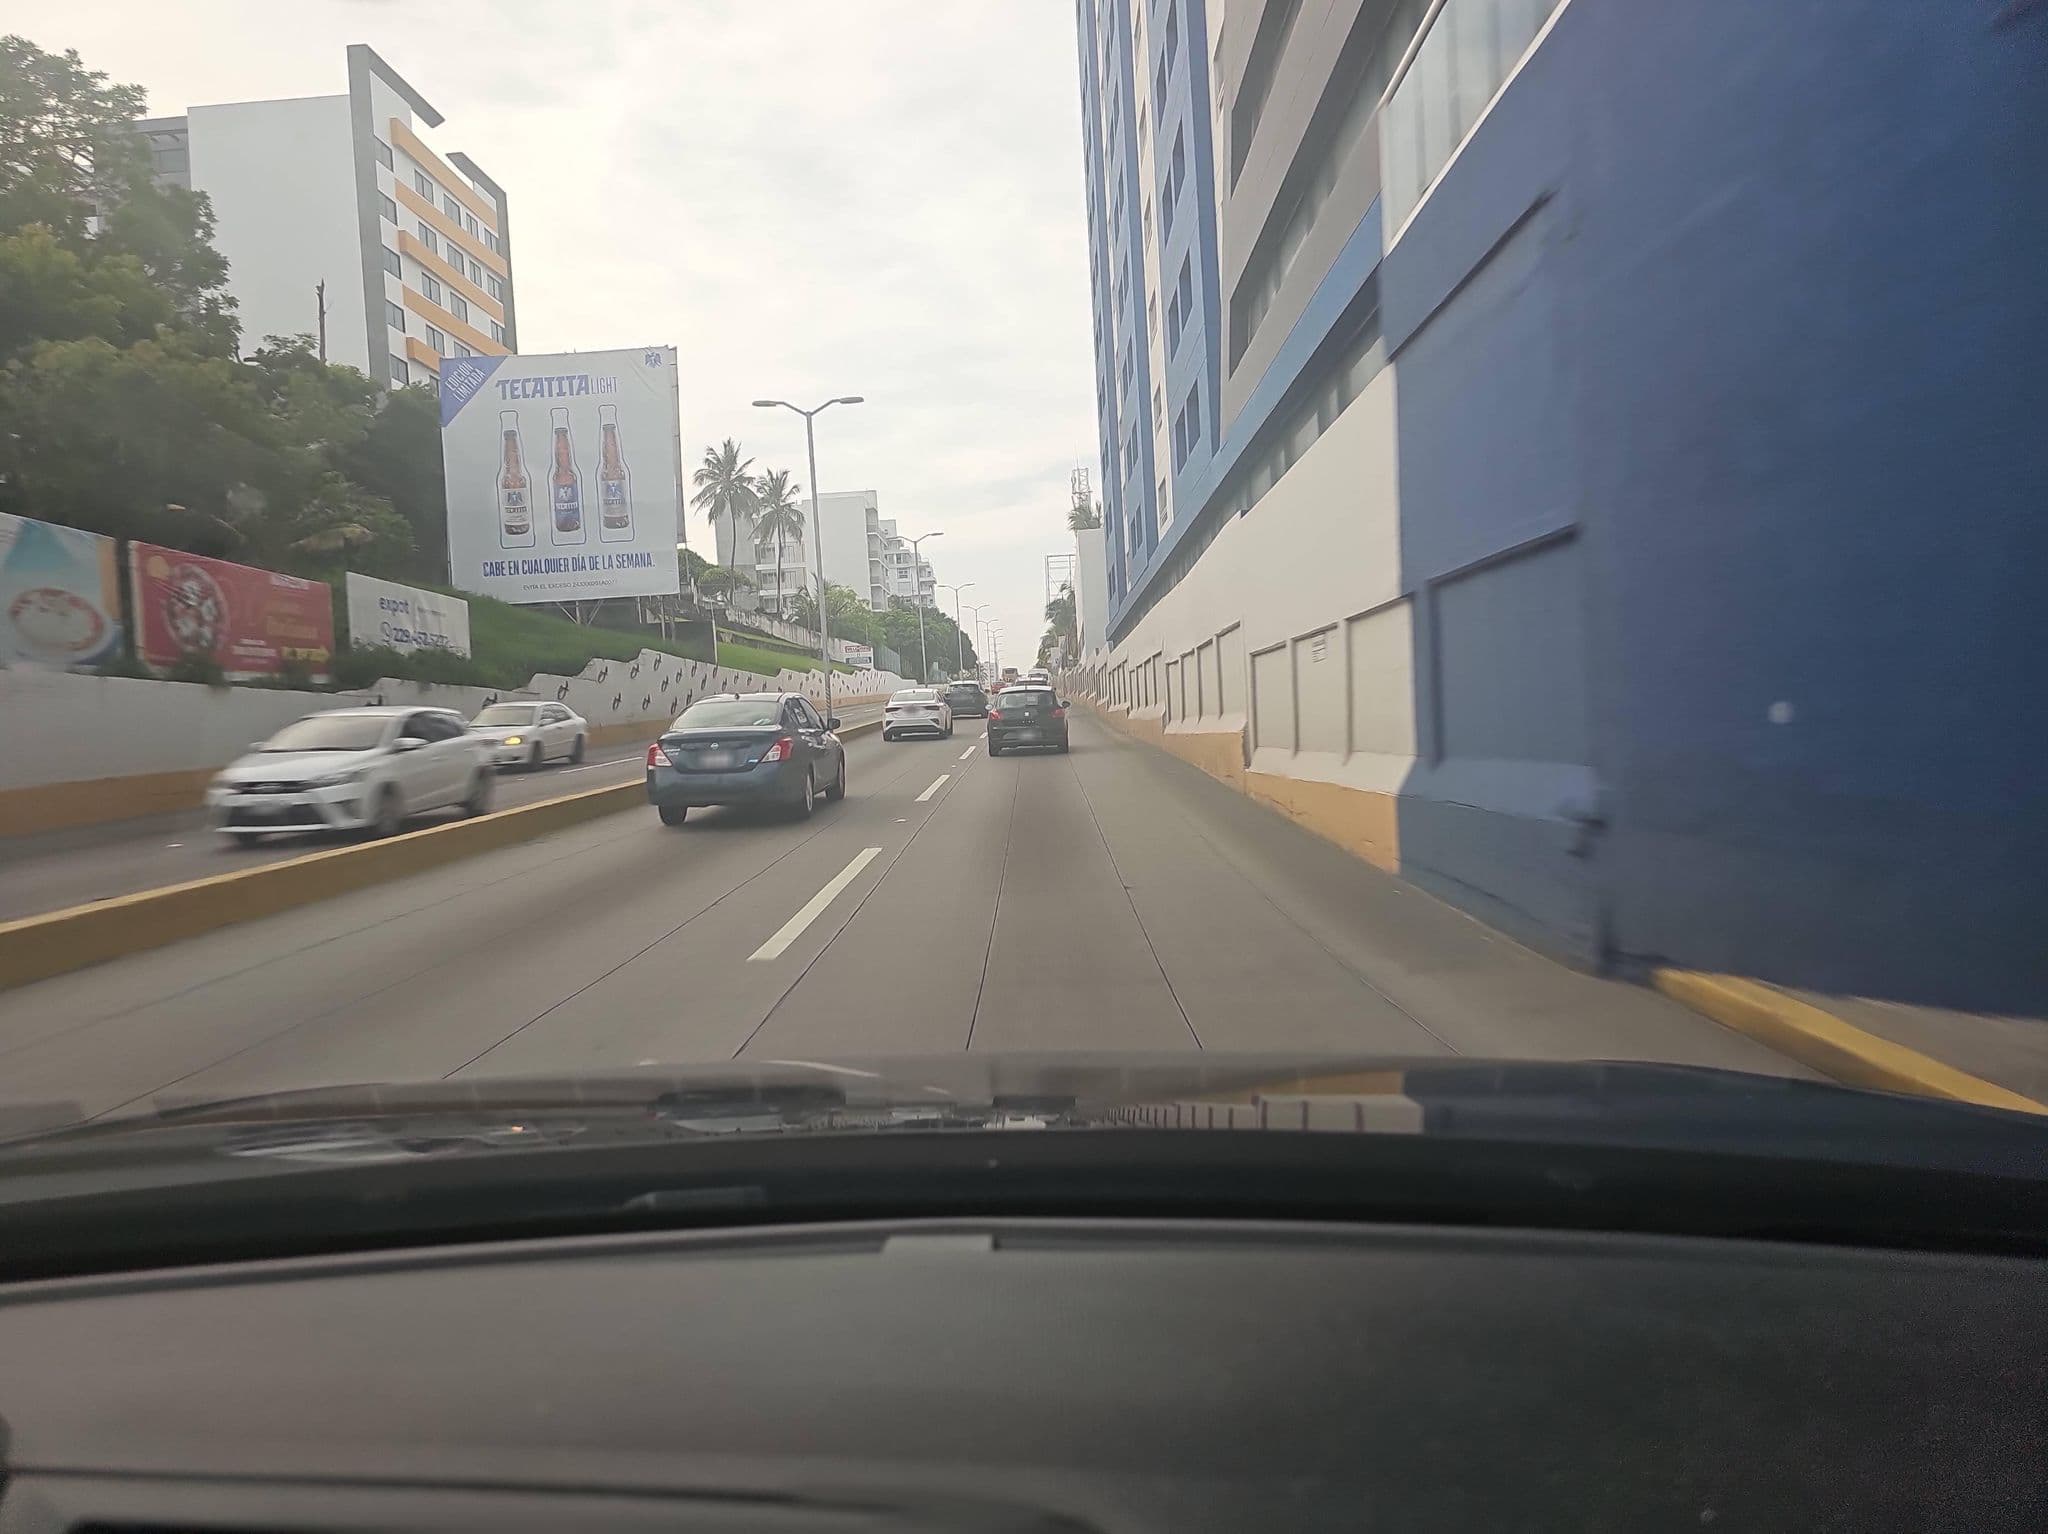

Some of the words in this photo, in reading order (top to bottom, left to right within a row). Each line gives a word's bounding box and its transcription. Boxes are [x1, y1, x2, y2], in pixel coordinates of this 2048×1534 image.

[453, 368, 486, 402] LIMITADA
[495, 375, 590, 400] TECATITA
[591, 376, 618, 394] LIGHT
[483, 561, 506, 577] CABE
[508, 560, 519, 575] EN
[522, 557, 569, 574] CUALQUIER
[572, 554, 587, 572] DÍA
[588, 556, 600, 570] DE
[602, 554, 613, 570] LA
[616, 552, 656, 569] SEMANA.
